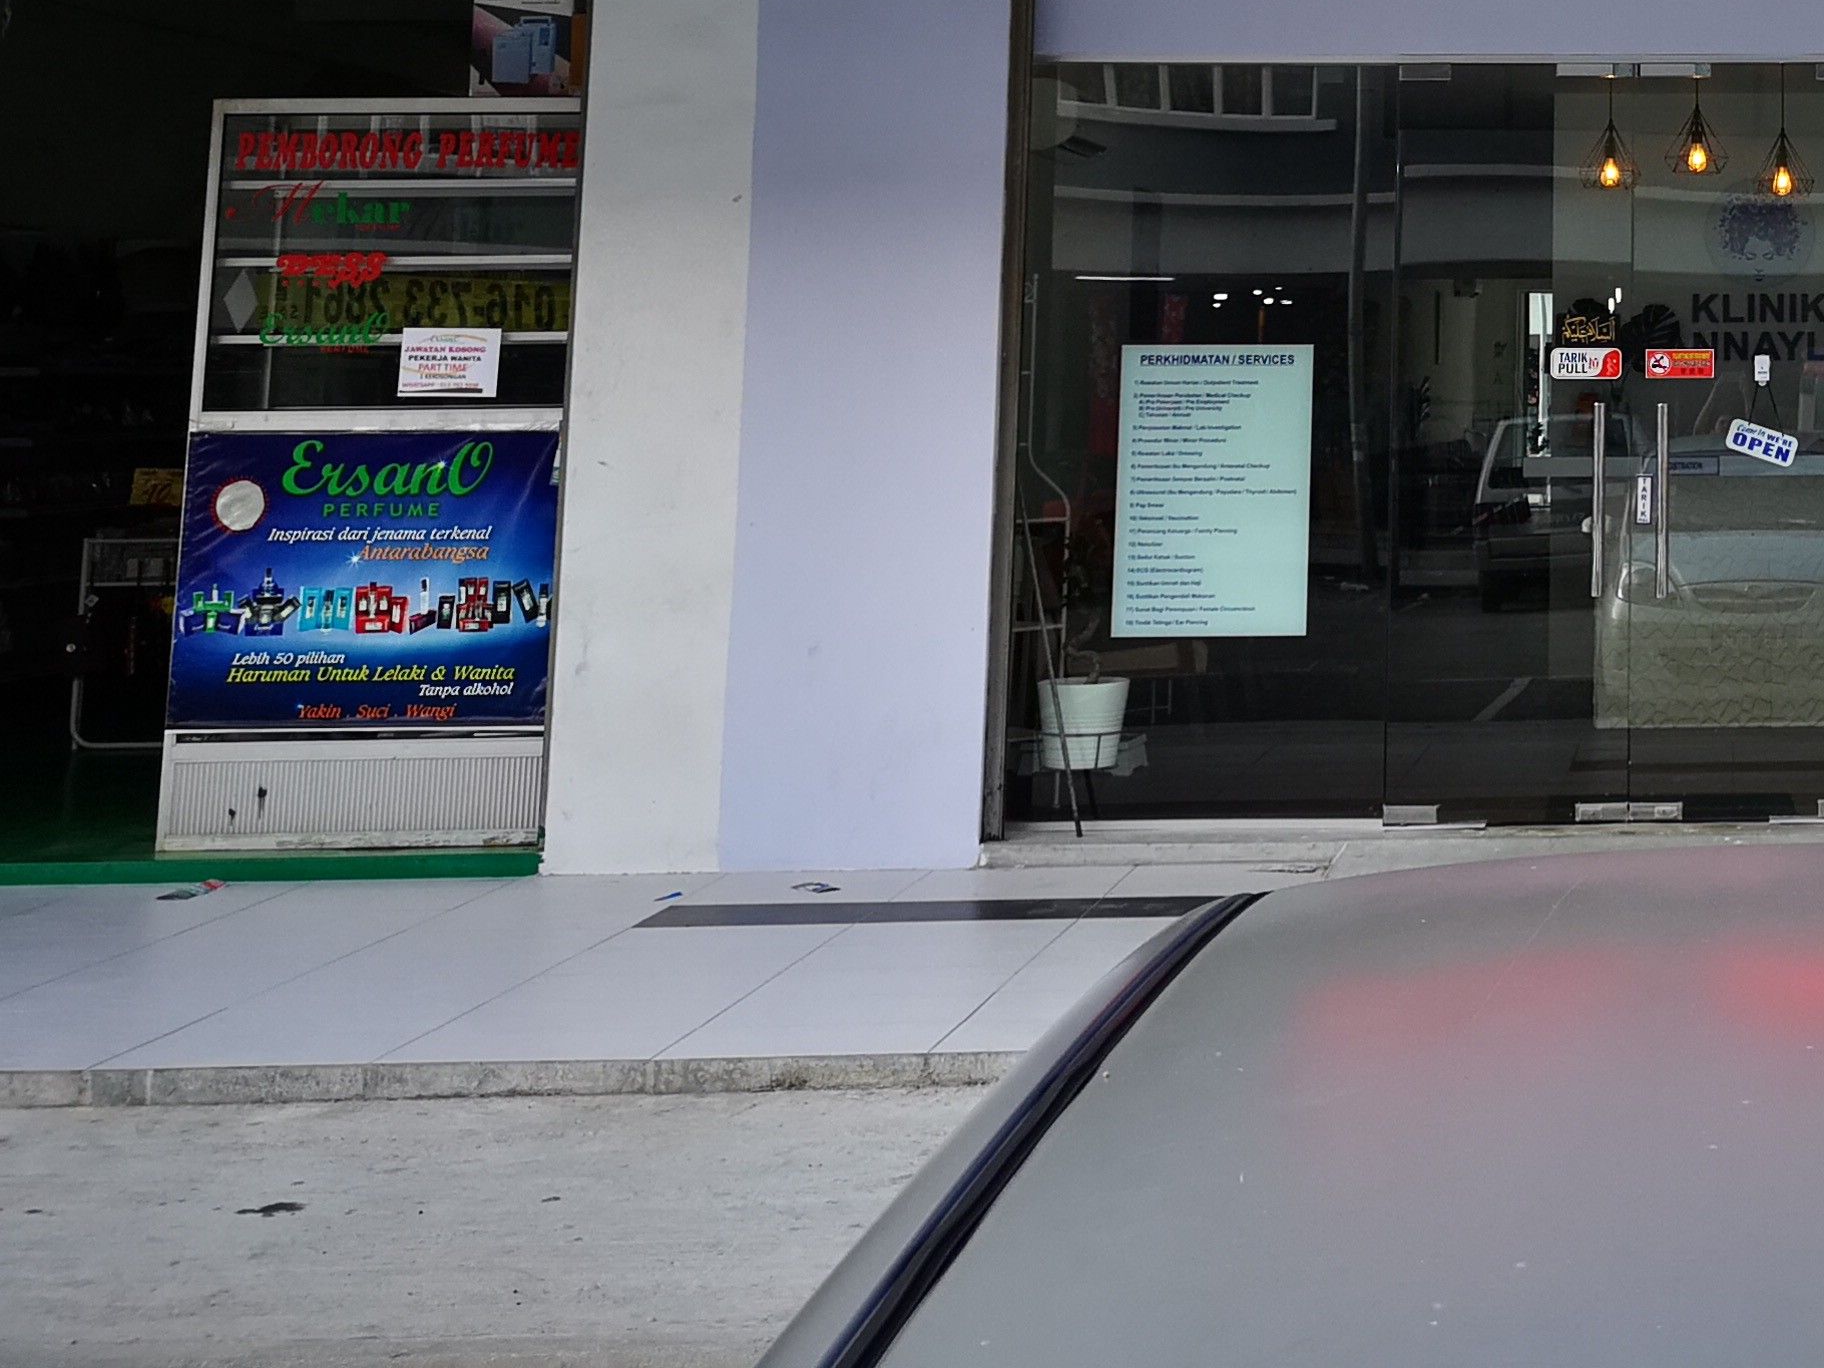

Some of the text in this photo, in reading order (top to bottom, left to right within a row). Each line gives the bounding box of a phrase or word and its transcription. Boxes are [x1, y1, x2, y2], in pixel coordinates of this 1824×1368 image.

[236, 130, 581, 170] PEMBORONG PERFUME
[1140, 354, 1230, 365] PERKHIDMATAN
[1237, 354, 1295, 365] SERVICES
[1559, 352, 1588, 363] TARIK
[1558, 363, 1588, 374] PULL
[1732, 432, 1791, 463] OPEN
[323, 503, 440, 517] PERFUME
[267, 525, 492, 543] Inspirasi dari jenama terkenal
[359, 543, 490, 564] Antarabangsa
[231, 652, 346, 667] Lebih 50 pilihan
[226, 664, 515, 683] Haruman Untuk Lelaki & Wanita
[418, 682, 514, 698] Tanpa alkohol
[297, 702, 458, 721] Yakin Suci Wangi
